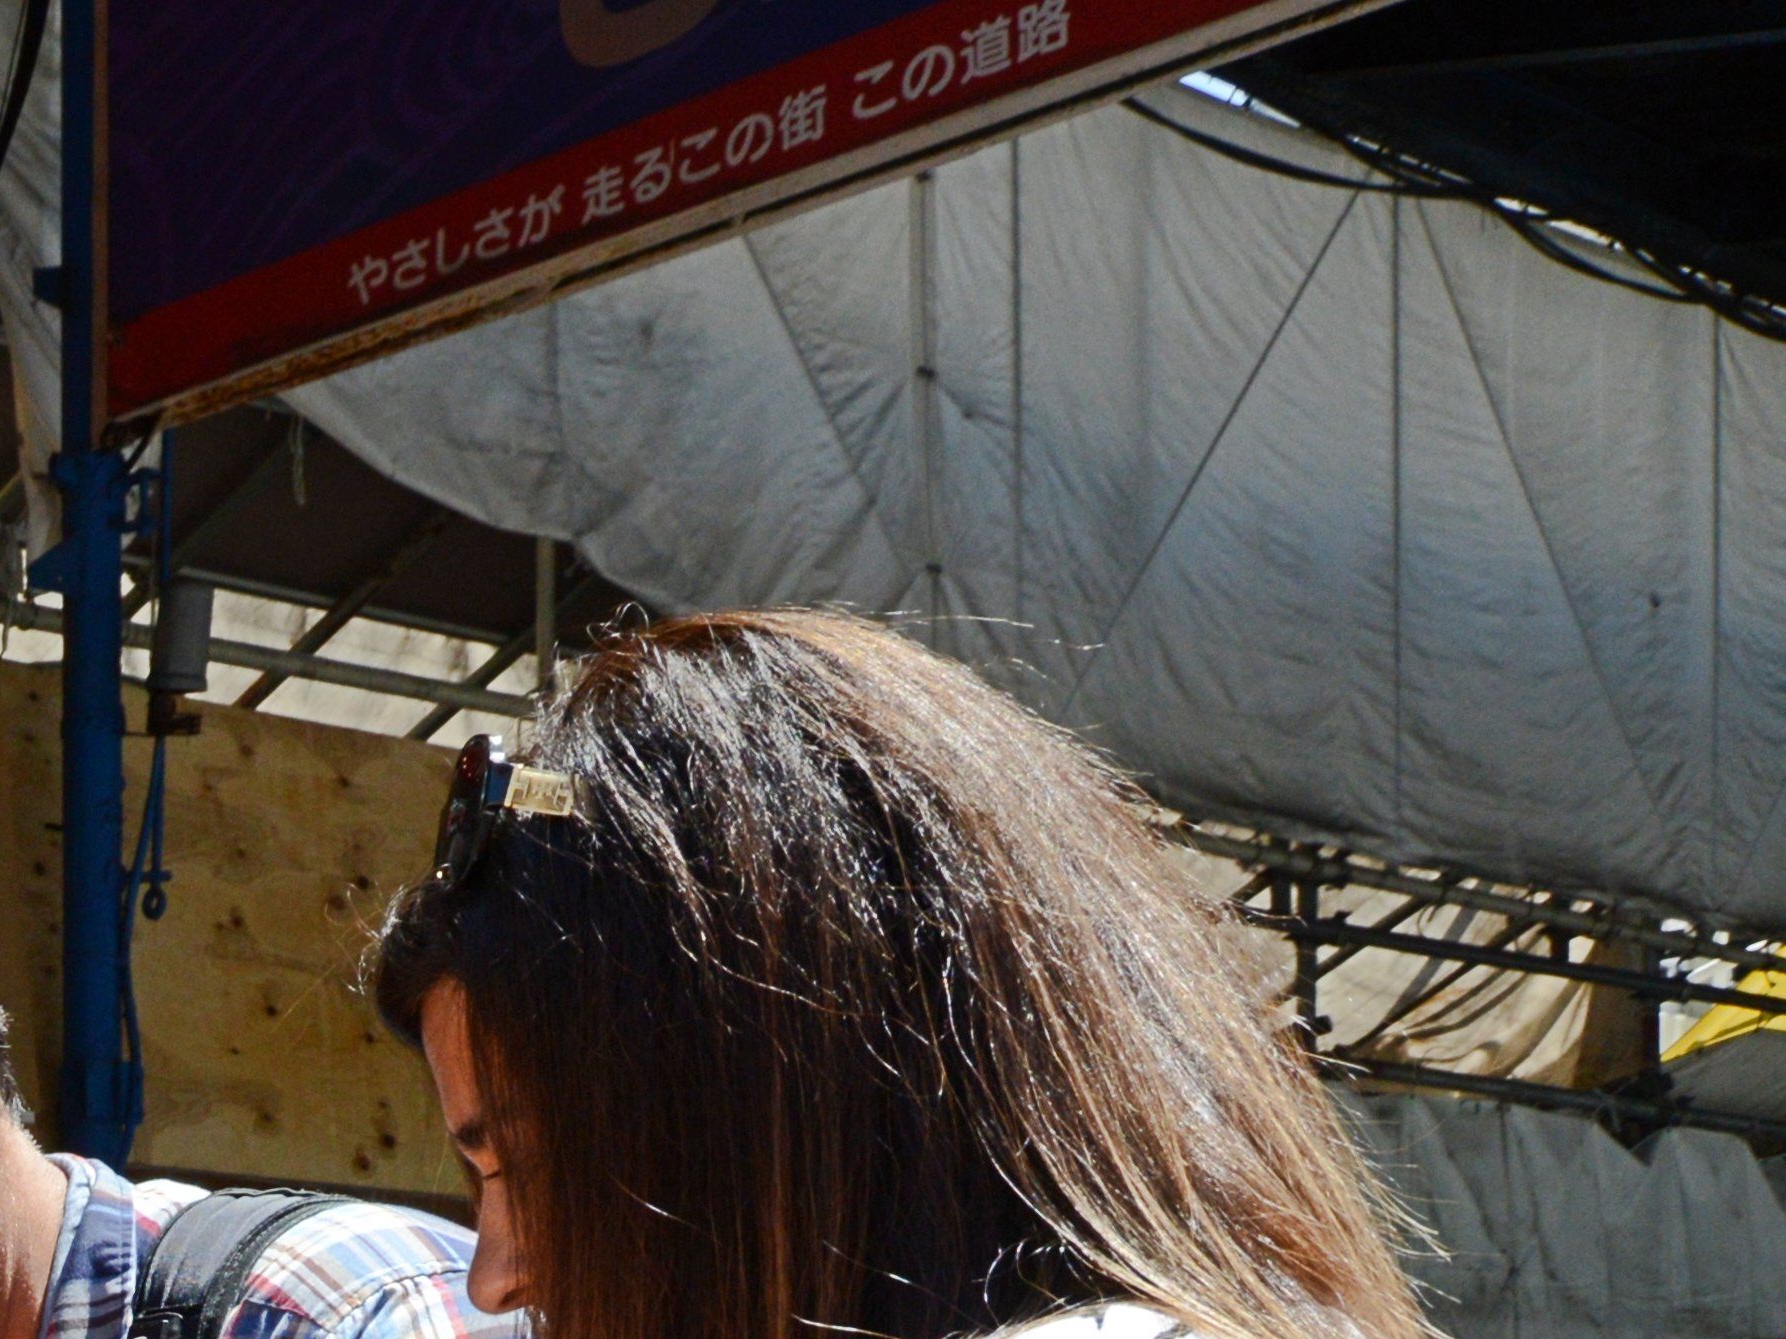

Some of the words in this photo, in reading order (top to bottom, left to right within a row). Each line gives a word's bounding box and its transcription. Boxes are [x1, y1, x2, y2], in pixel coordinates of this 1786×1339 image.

[346, 183, 566, 305] やさしさが
[848, 0, 1072, 120] この道路
